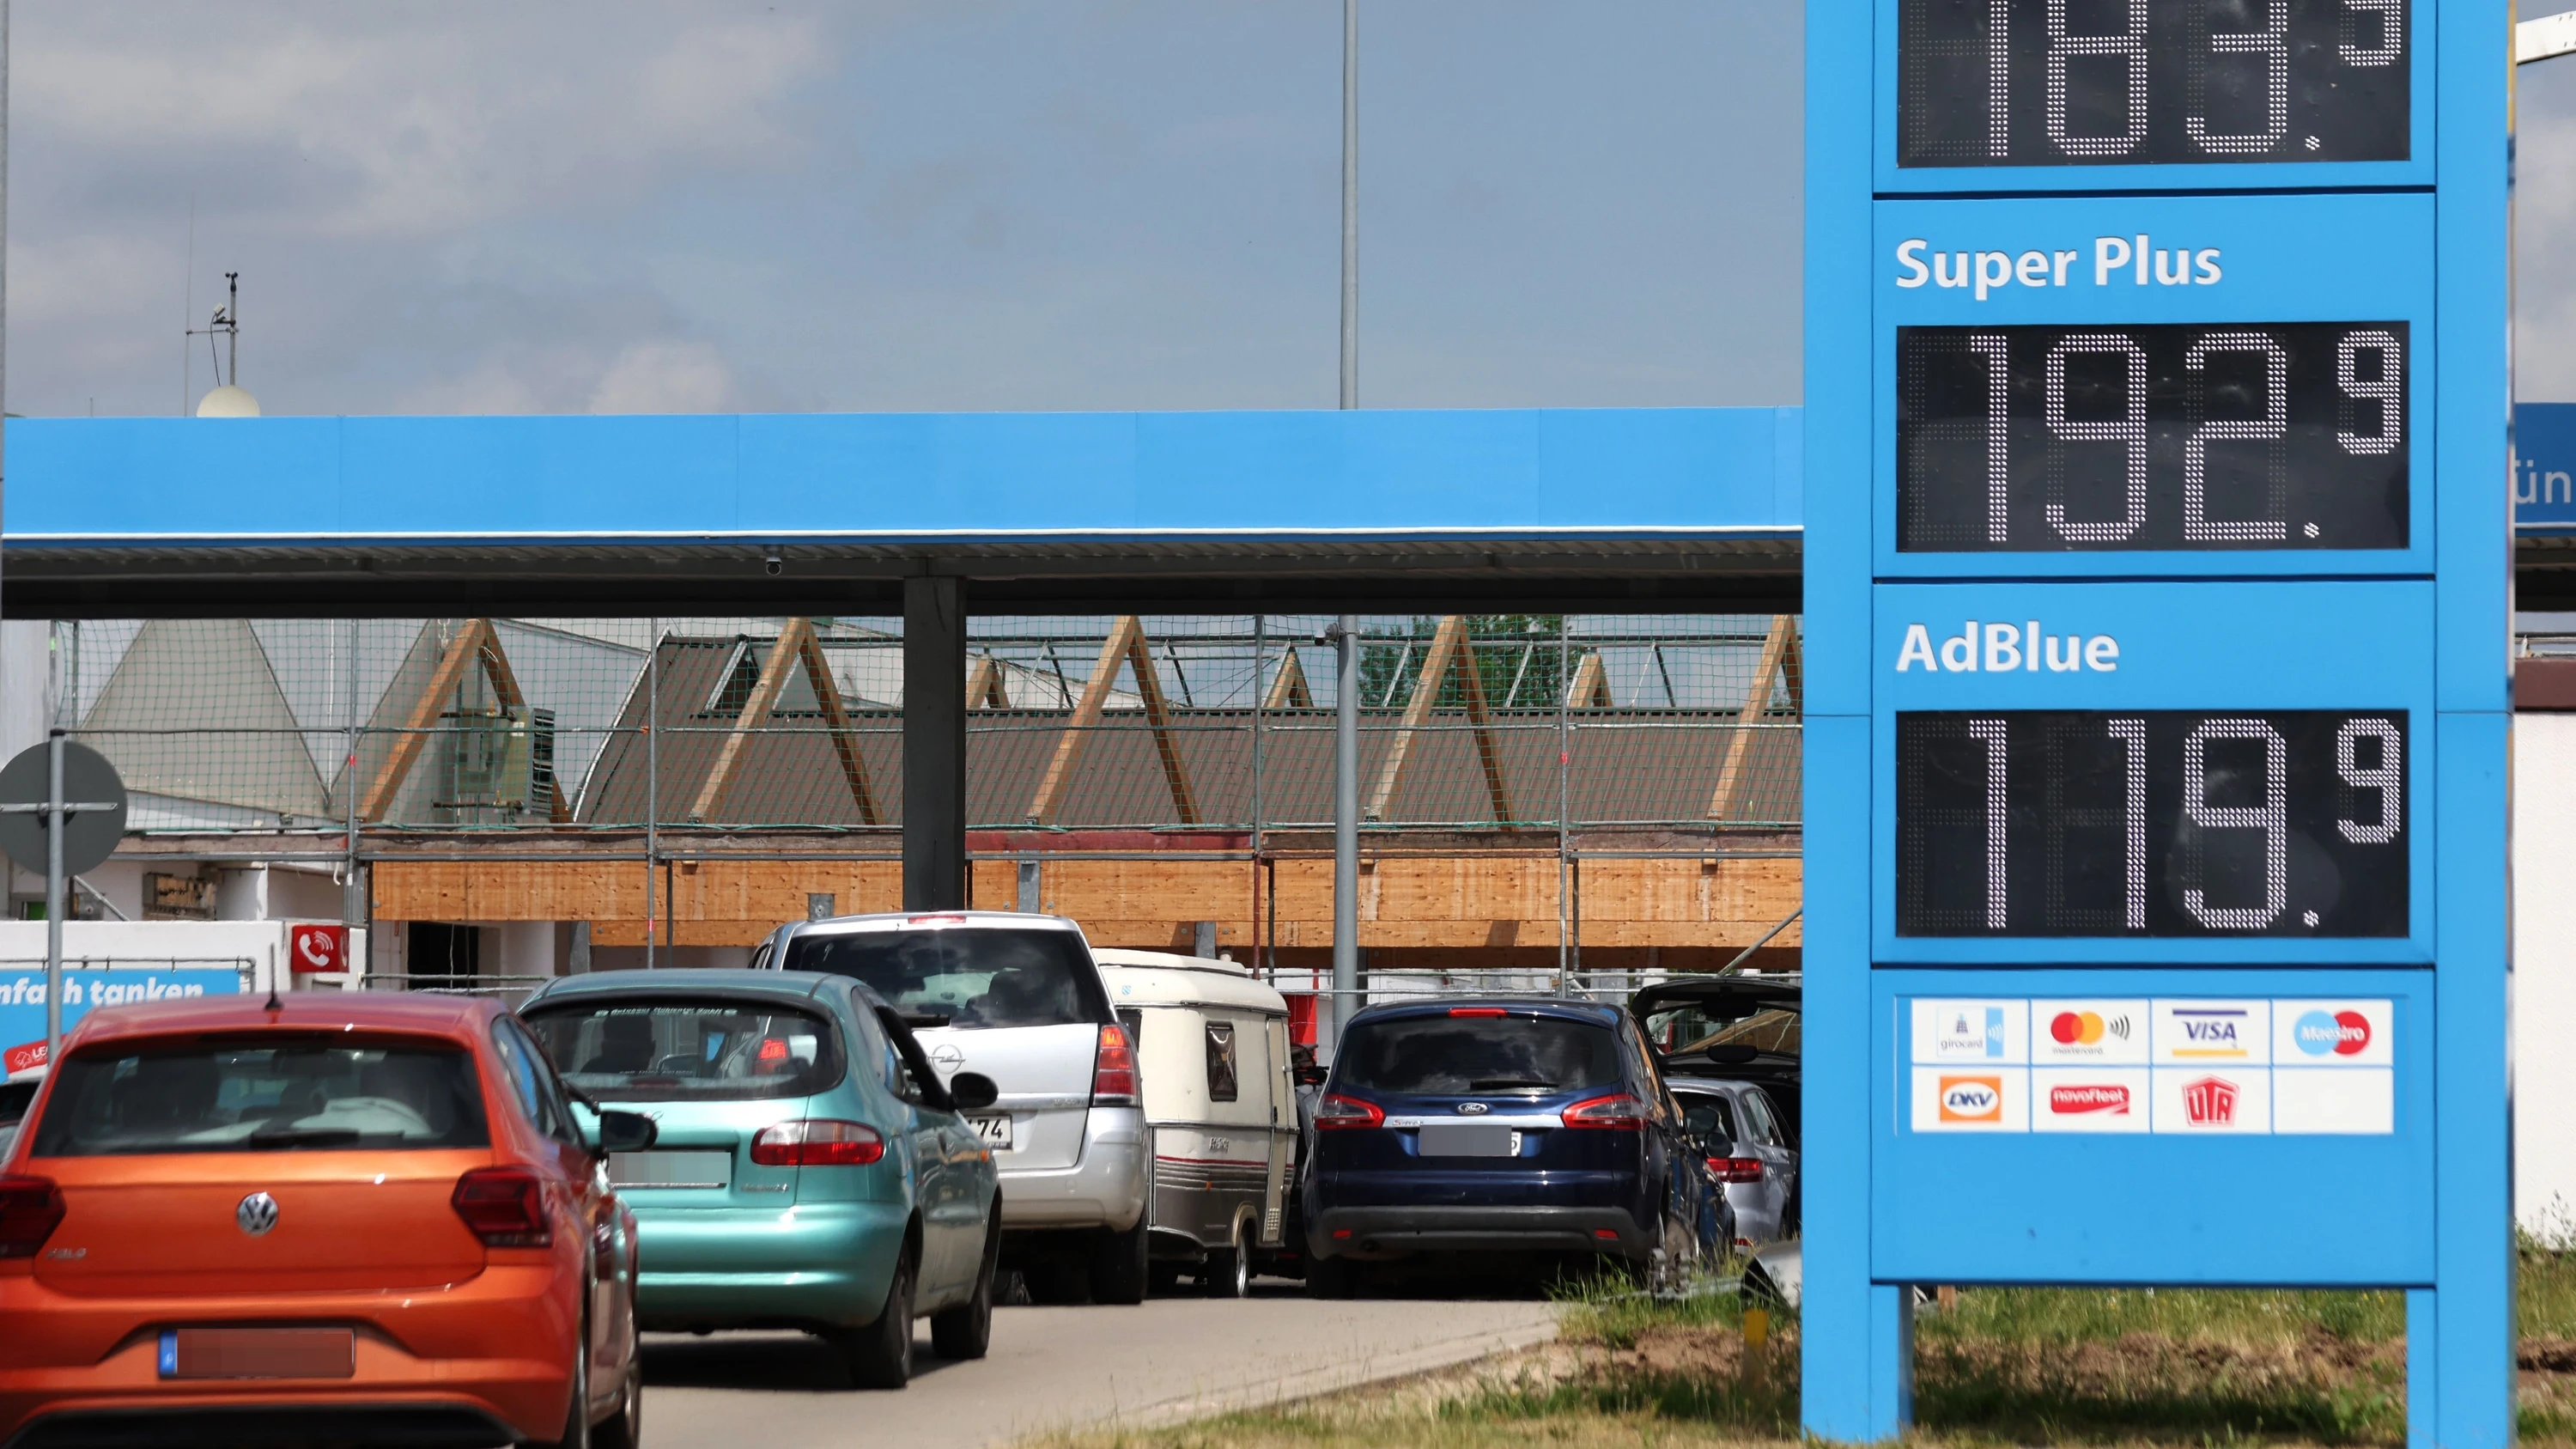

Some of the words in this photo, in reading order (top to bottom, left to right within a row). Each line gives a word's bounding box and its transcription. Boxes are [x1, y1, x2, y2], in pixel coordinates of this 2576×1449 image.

[1896, 239, 2077, 301] Super
[2094, 234, 2223, 286] Plus
[1895, 620, 2120, 673] AdBlue
[0, 977, 83, 1005] nfah
[89, 977, 204, 1007] tanken
[2183, 1021, 2238, 1041] VISA
[2300, 1025, 2366, 1041] Maestro
[32, 1045, 48, 1059] LE
[1941, 1038, 1984, 1050] girocard
[1947, 1092, 1993, 1106] DKV
[968, 1118, 1003, 1139] 74
